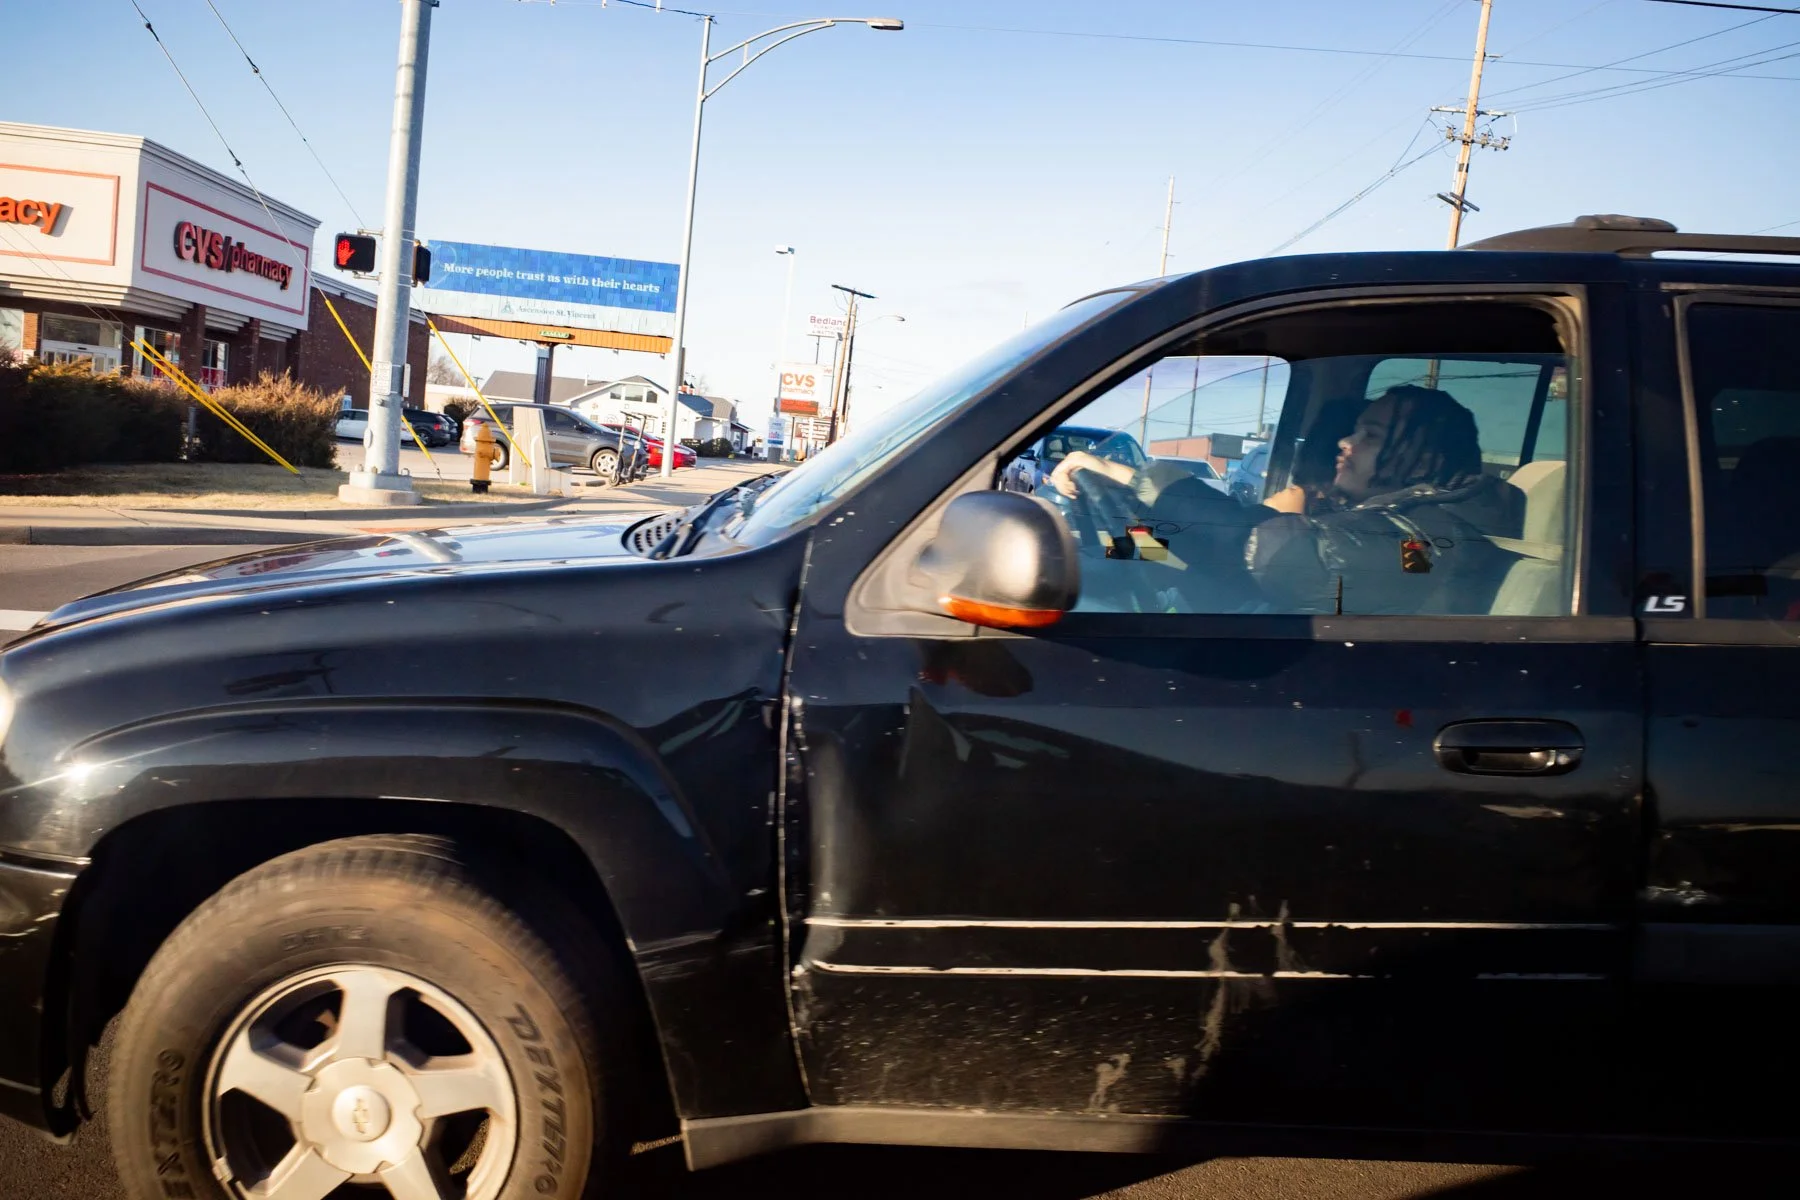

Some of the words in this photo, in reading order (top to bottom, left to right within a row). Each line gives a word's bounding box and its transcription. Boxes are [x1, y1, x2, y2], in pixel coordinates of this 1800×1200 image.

[0, 197, 61, 235] acy
[443, 262, 474, 275] More
[476, 267, 514, 280] people
[516, 270, 545, 282] trust
[547, 273, 561, 283] us
[562, 274, 590, 286] with
[591, 276, 622, 289] their
[622, 279, 660, 293] hearts
[782, 372, 816, 387] CVS
[1644, 595, 1687, 612] LS
